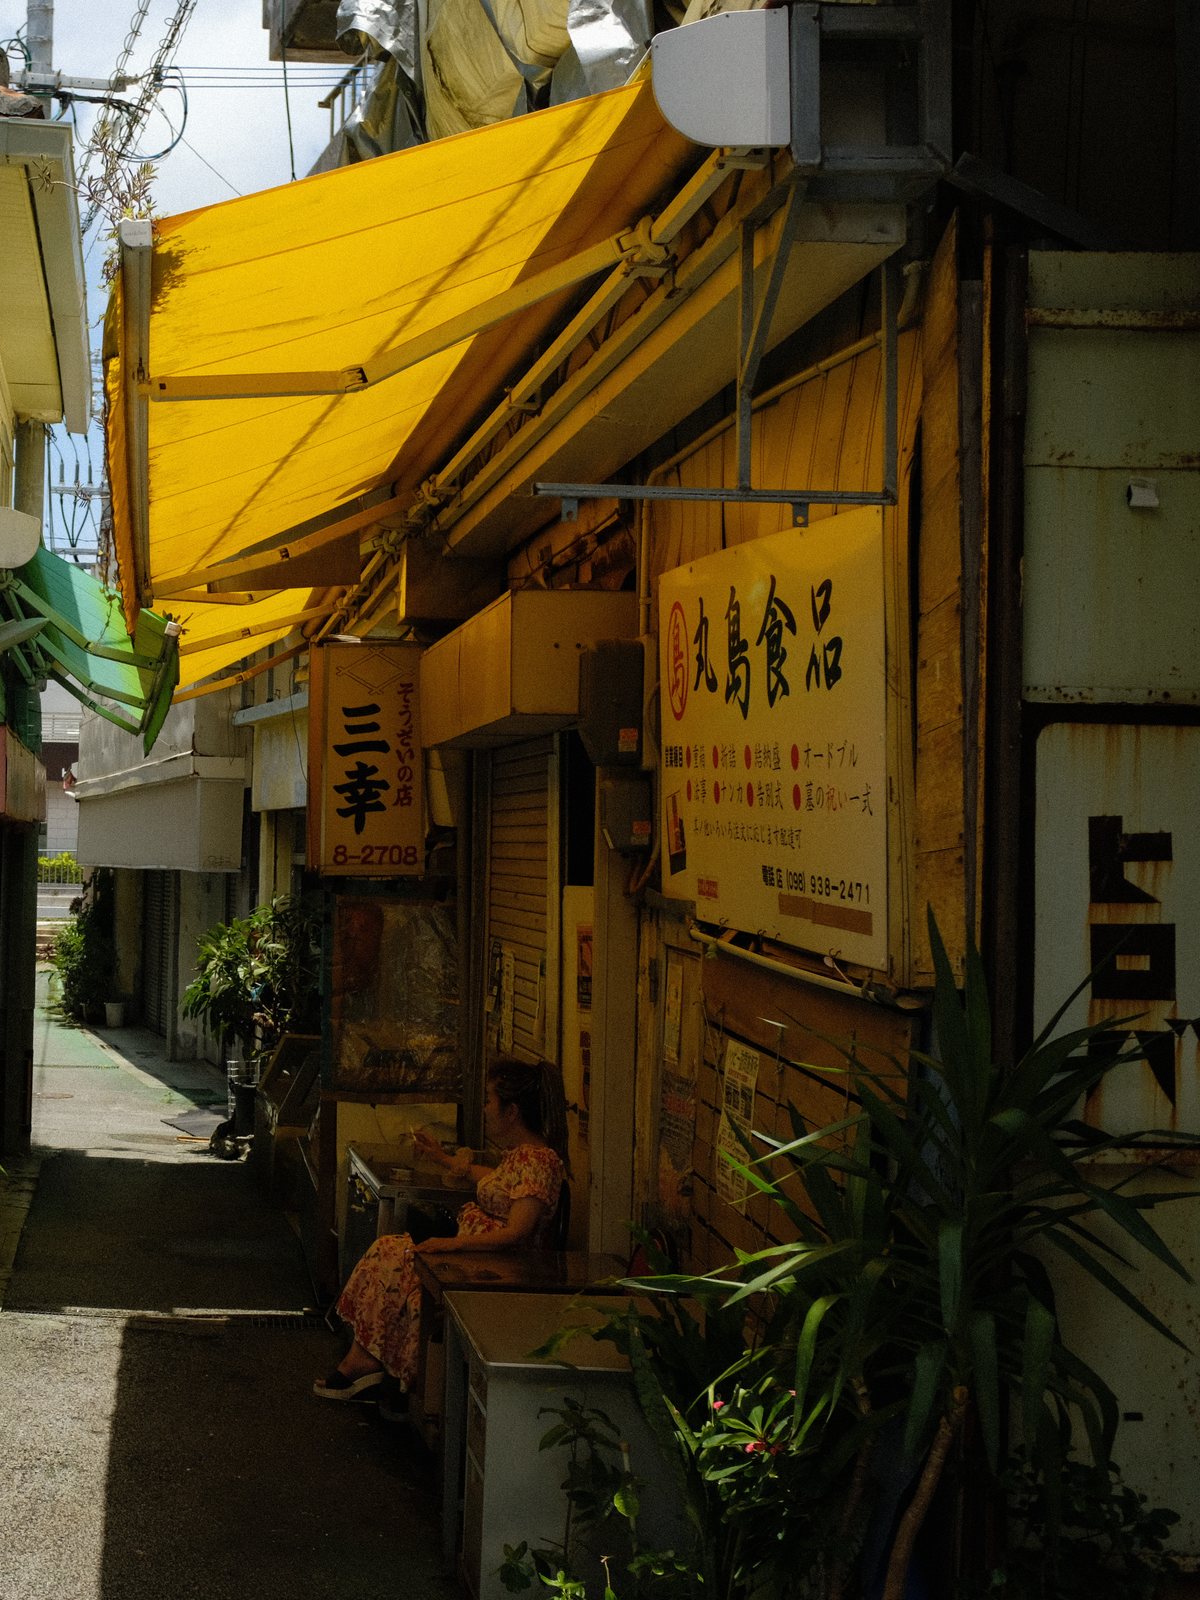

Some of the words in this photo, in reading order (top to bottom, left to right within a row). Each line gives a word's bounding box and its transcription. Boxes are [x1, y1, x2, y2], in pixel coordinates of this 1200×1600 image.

[693, 575, 842, 720] 丸島食品
[393, 683, 414, 806] そうざいの店
[804, 739, 858, 768] オードブル
[333, 703, 390, 834] 三幸
[805, 780, 873, 816] 墓の祝い一式
[333, 845, 418, 866] 8-2708
[787, 869, 805, 894] (098)
[811, 875, 870, 904] 938-2471
